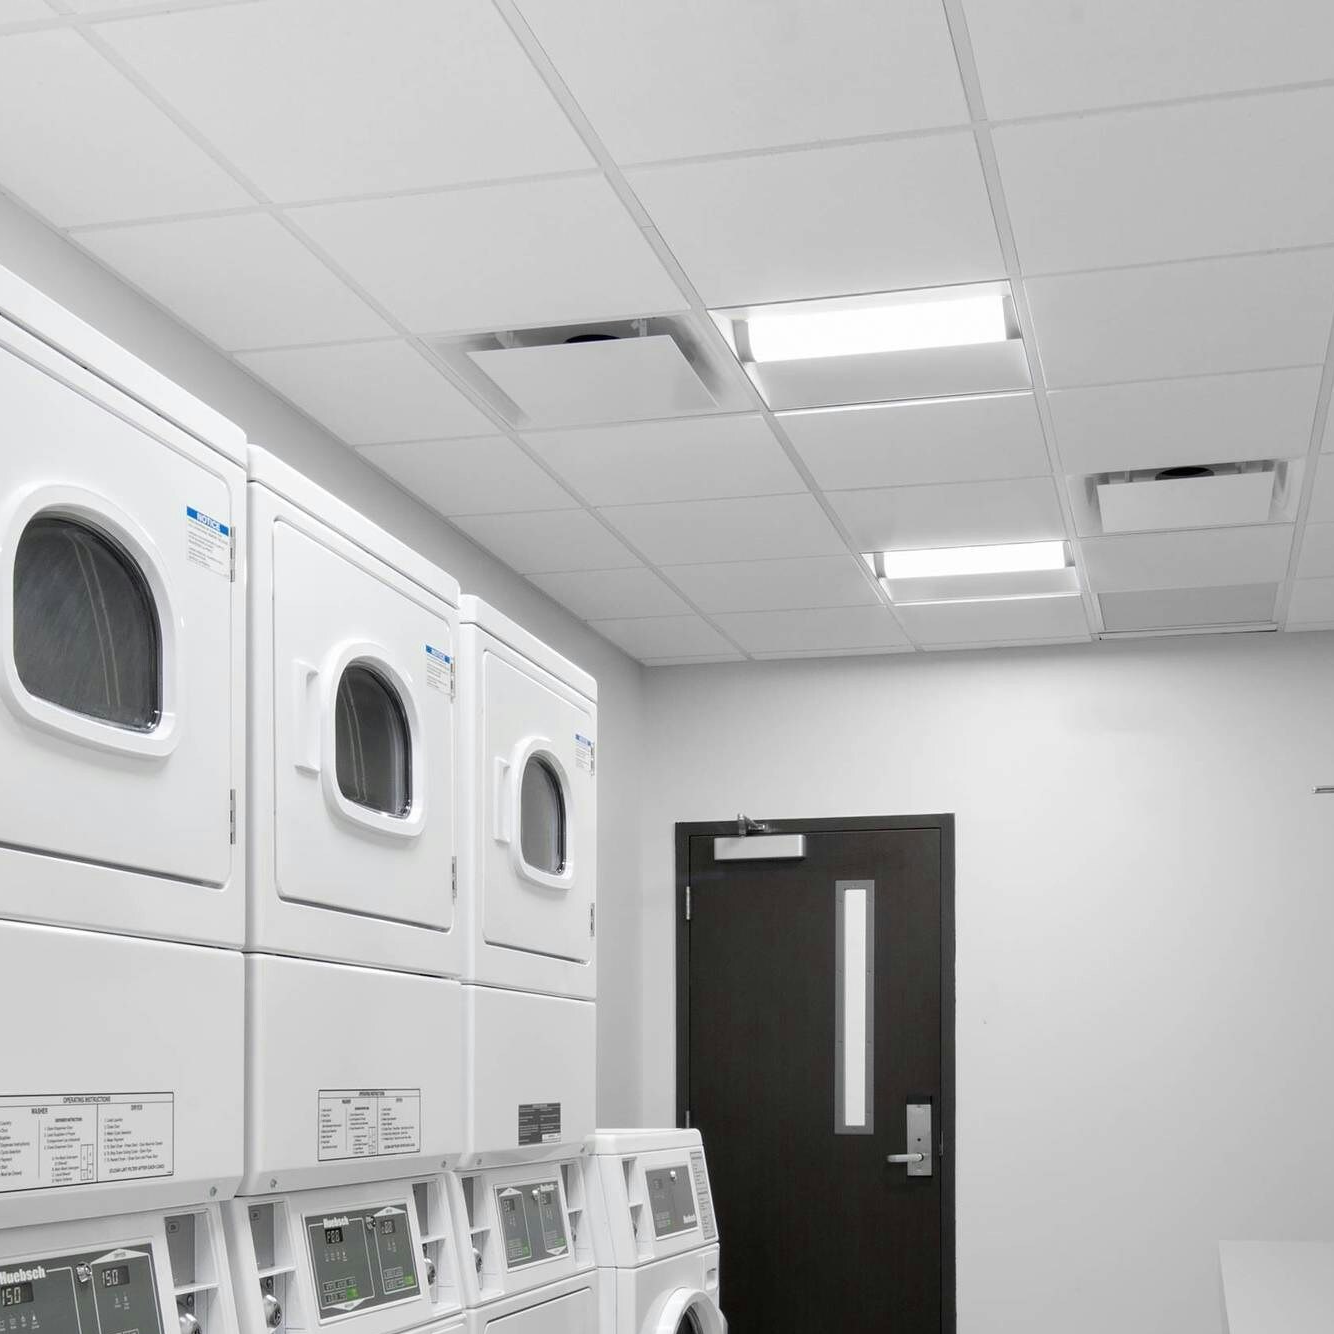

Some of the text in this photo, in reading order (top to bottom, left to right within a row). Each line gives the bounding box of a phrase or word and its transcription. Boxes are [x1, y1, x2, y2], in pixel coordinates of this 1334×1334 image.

[0, 1265, 46, 1285] Huebsch
[102, 1269, 118, 1287] 150
[2, 1286, 21, 1306] 150
